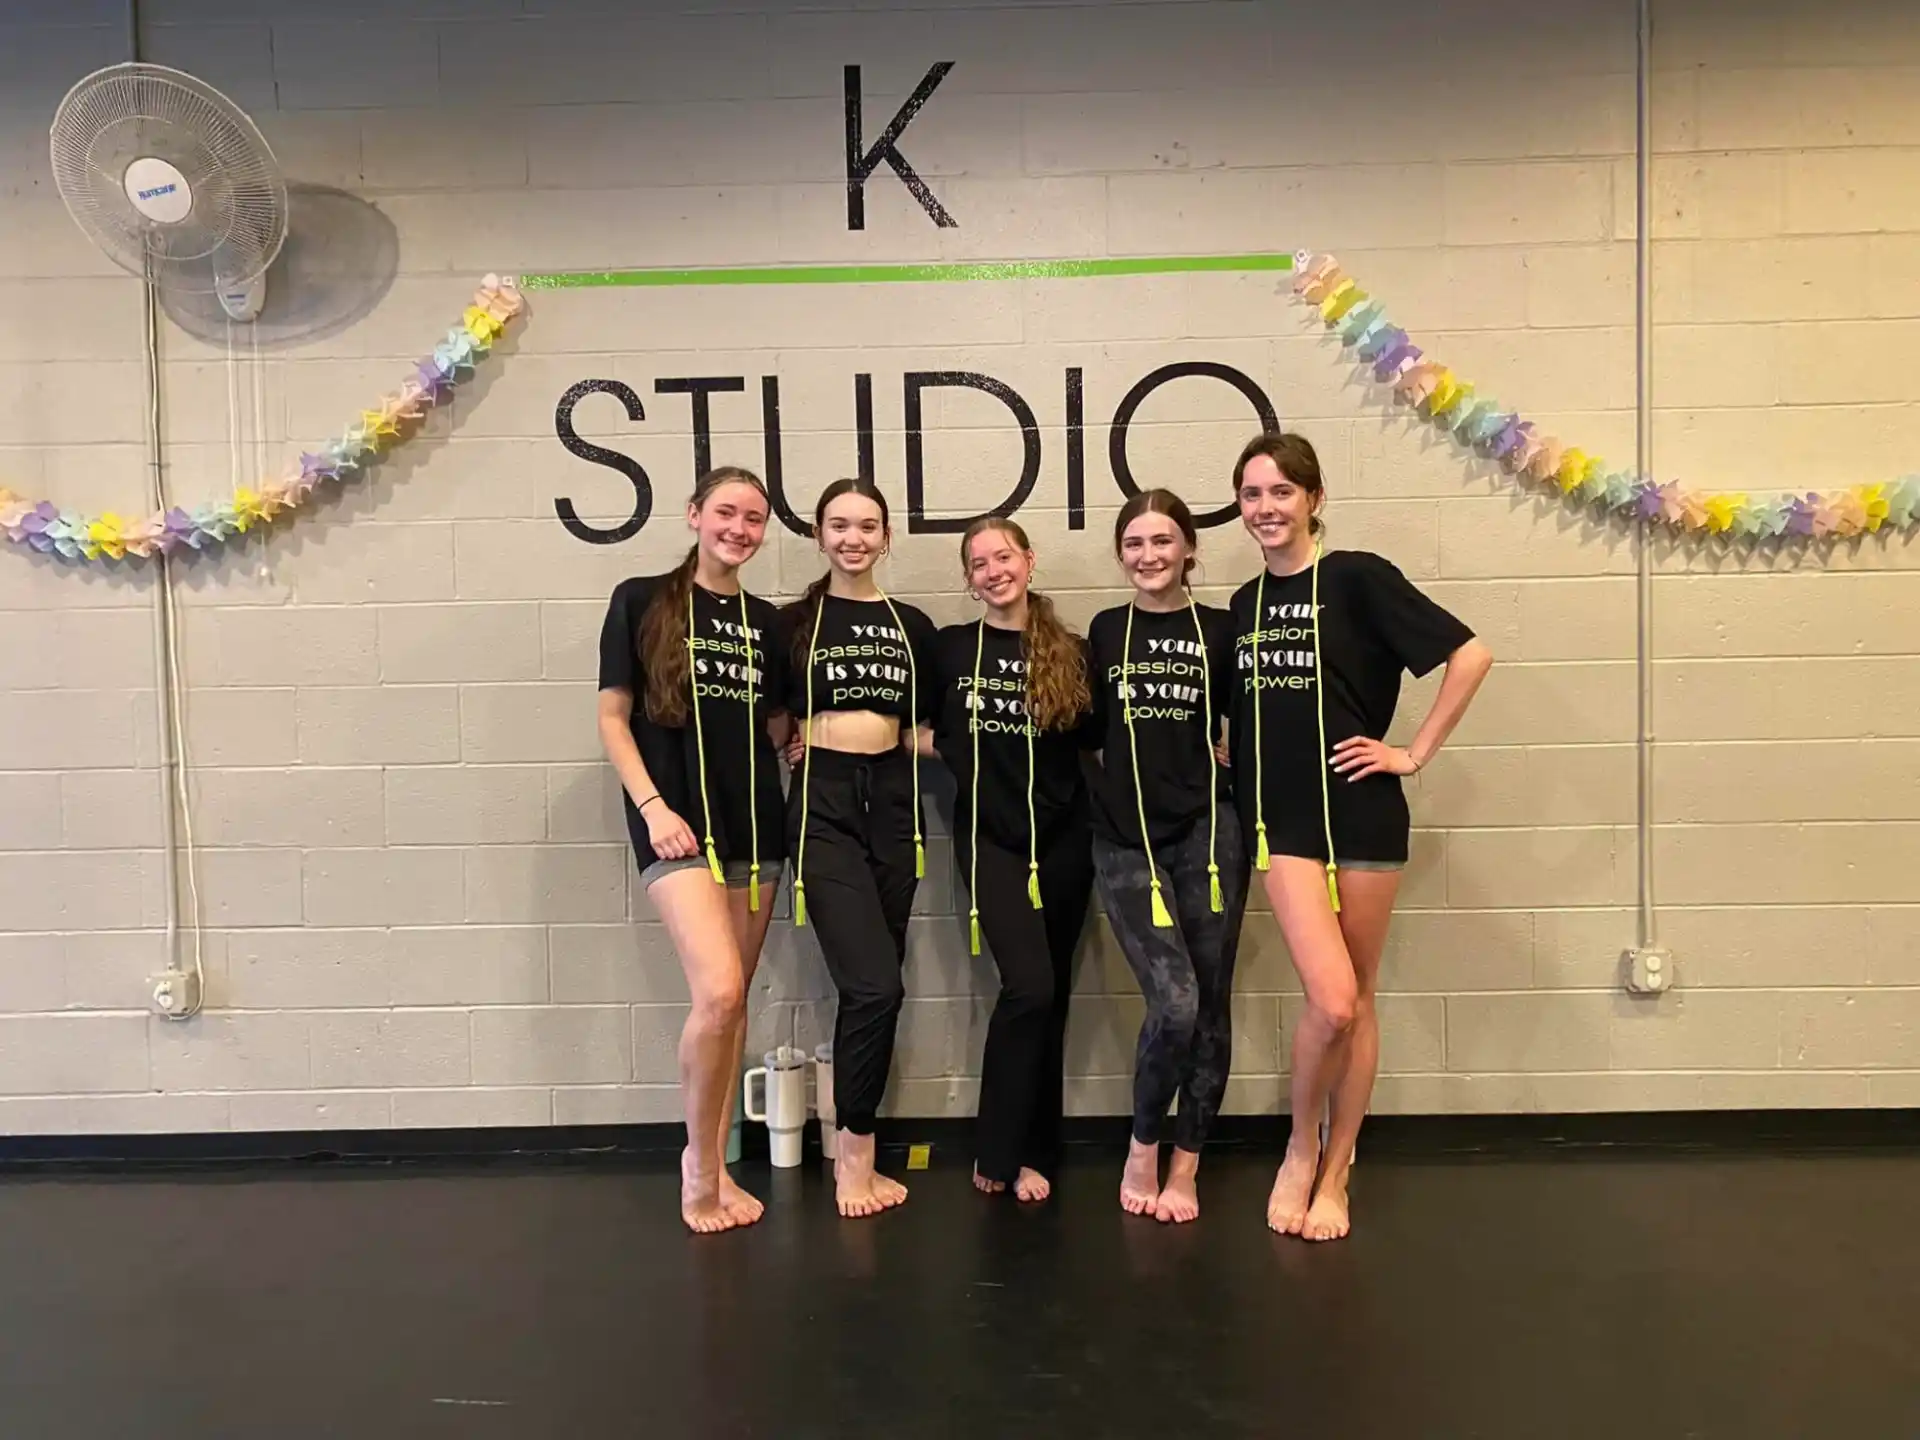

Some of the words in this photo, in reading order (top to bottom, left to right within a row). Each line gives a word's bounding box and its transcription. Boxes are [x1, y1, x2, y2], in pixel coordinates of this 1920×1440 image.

[843, 61, 959, 230] K
[553, 362, 1280, 544] STUDIO
[1267, 603, 1326, 621] your
[711, 618, 763, 641] your
[850, 625, 905, 643] your
[813, 641, 909, 666] passion
[1147, 638, 1208, 658] your
[997, 658, 1028, 674] yo
[1237, 650, 1254, 669] is
[1259, 649, 1316, 668] your
[714, 660, 764, 686] your
[826, 662, 848, 681] is
[853, 663, 909, 684] your
[1108, 658, 1204, 684] passion
[833, 684, 904, 705] power
[957, 676, 1028, 692] passi
[1117, 681, 1137, 700] is
[1143, 682, 1205, 704] your
[1244, 675, 1317, 695] power
[1123, 705, 1196, 725] power
